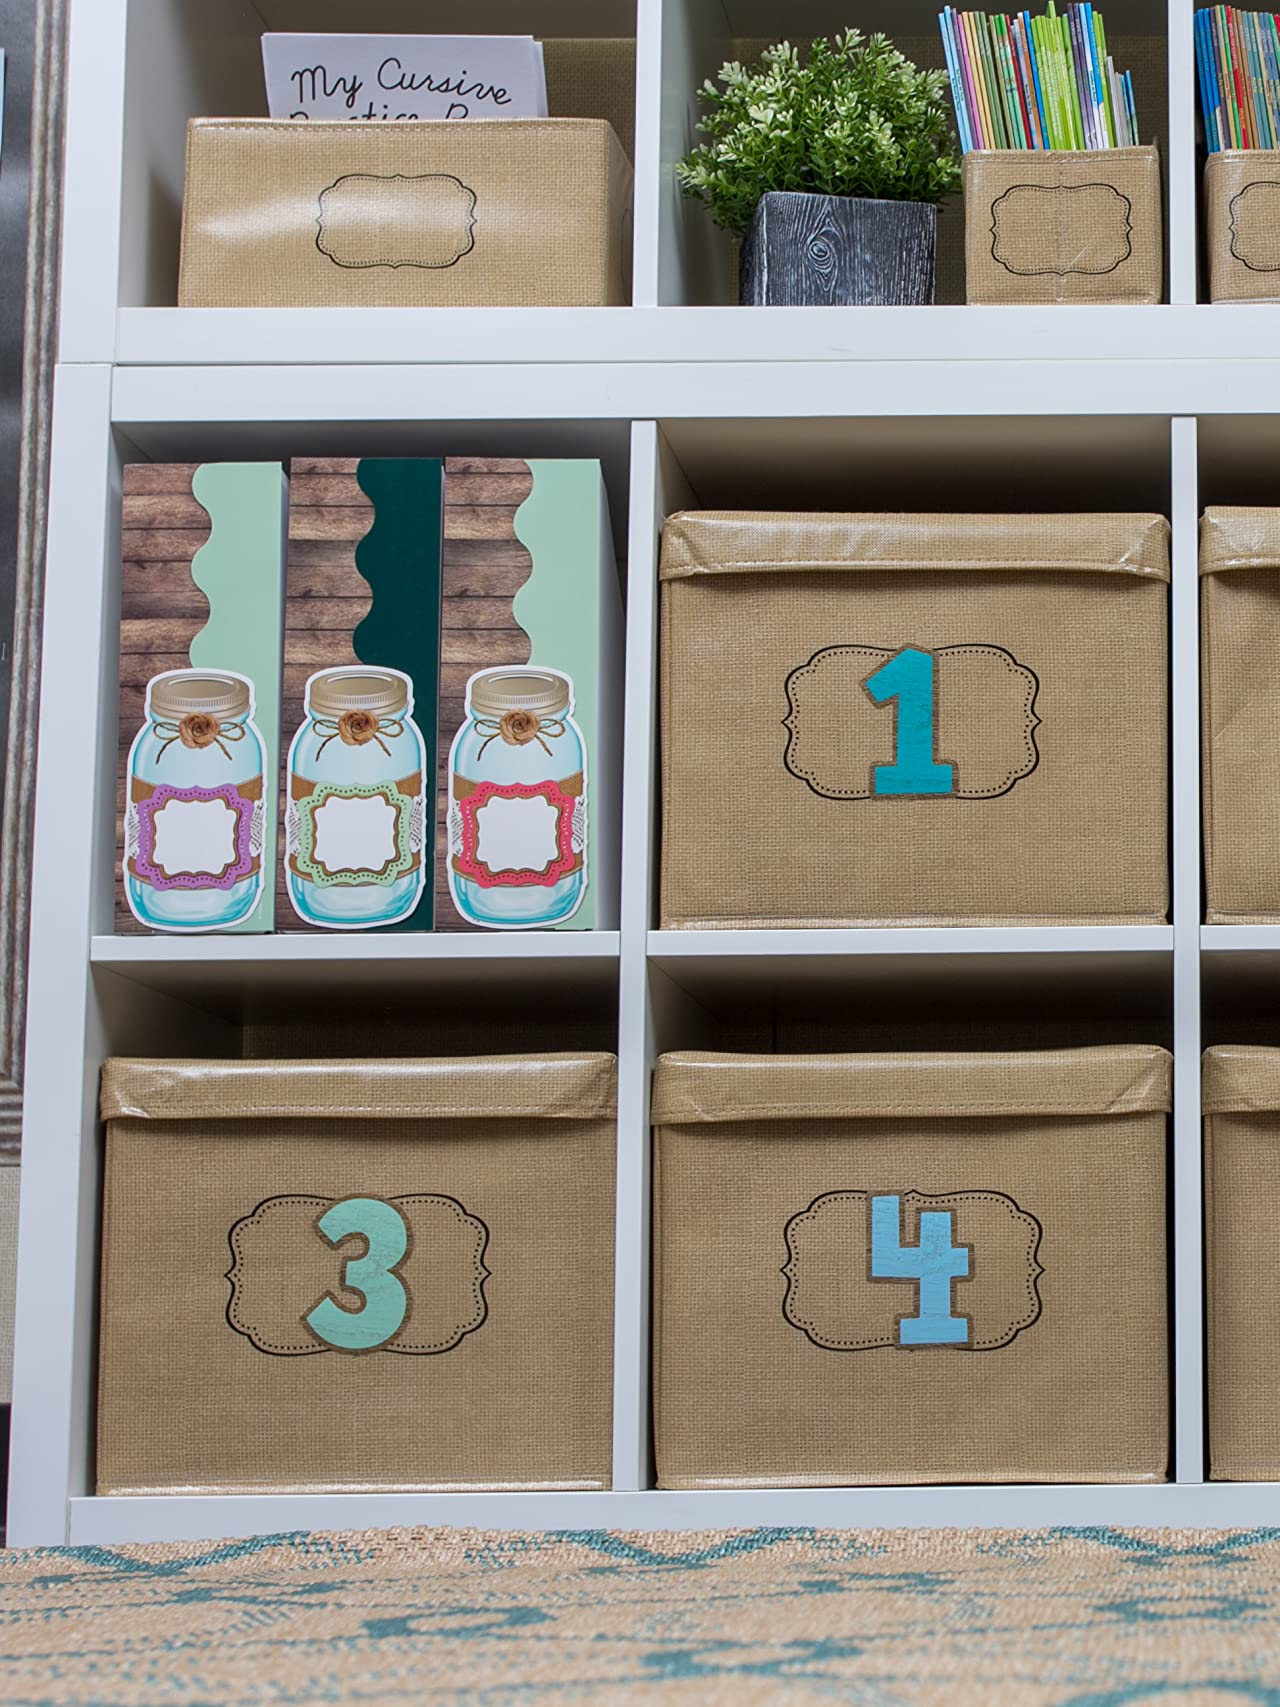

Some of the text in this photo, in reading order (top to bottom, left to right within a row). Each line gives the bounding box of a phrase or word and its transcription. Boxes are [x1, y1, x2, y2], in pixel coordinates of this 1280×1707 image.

[291, 57, 513, 108] My Cursive
[861, 643, 958, 800] 1
[301, 1193, 413, 1354] 3
[867, 1190, 974, 1350] 4
